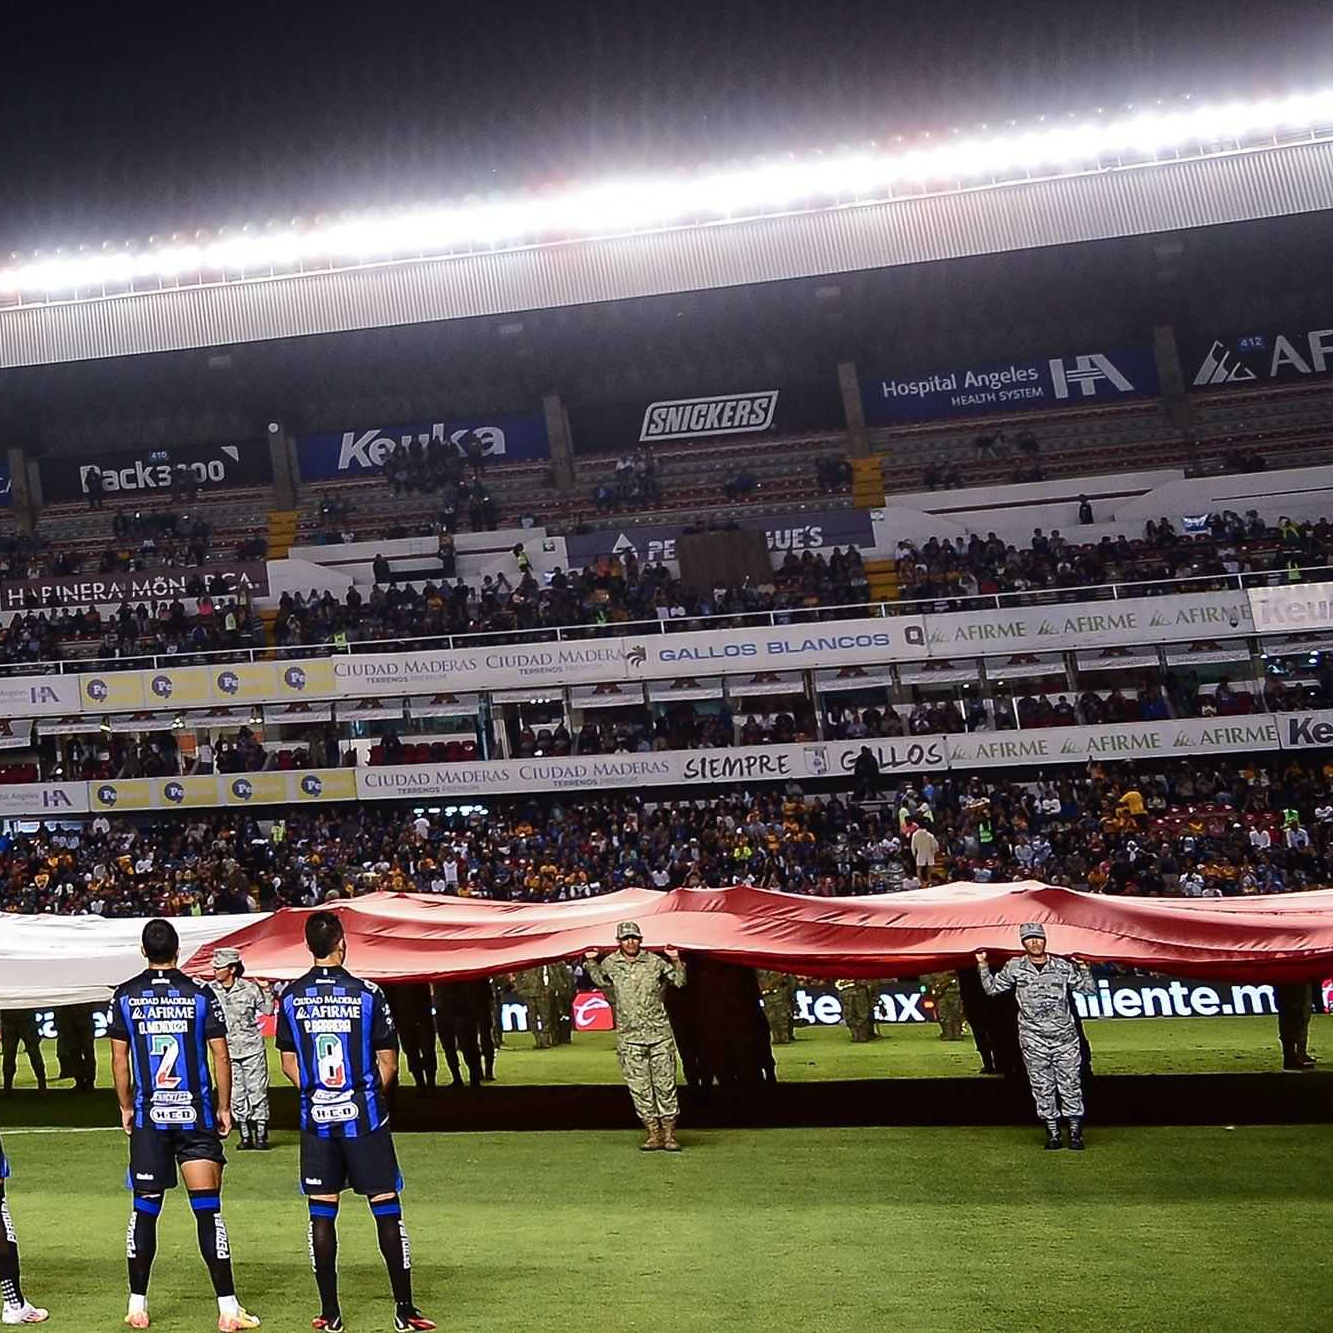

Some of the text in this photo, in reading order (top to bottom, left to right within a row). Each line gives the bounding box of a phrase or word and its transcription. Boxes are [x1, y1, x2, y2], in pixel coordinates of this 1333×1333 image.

[1240, 336, 1262, 346] 412
[882, 366, 1038, 399] Hospital Angeles
[951, 387, 1044, 407] HEALTH SYSTEM
[649, 399, 768, 434] SNICKERS
[955, 622, 1027, 641] AFIRME
[1063, 613, 1137, 634] AFIRME
[1175, 604, 1251, 624] AFIRME
[659, 643, 757, 662] GALLOS
[767, 633, 890, 655] BLANCOS
[335, 654, 552, 678] CIUDAD MADERAS CIUDAD
[366, 675, 408, 684] TERRENOS
[519, 667, 561, 675] TERRENOS
[975, 725, 1277, 759] AFIRME AFIRME AFIRME
[365, 773, 429, 788] CIUDAD
[435, 769, 509, 785] MADERAS
[519, 764, 587, 782] CIUDAD
[593, 761, 669, 776] MADERAS
[684, 744, 942, 780] SIEMPRE GLLOS
[397, 778, 598, 794] TERRENOS TERRENOS
[129, 997, 160, 1006] CIUDAD
[147, 1006, 195, 1019] AFIRME
[293, 997, 322, 1006] CIUDAD
[313, 1006, 361, 1019] AFIRME
[150, 1035, 182, 1090] 2
[315, 1034, 345, 1089] 8
[125, 1211, 137, 1258] PERDURA
[214, 1212, 230, 1260] PERDURA
